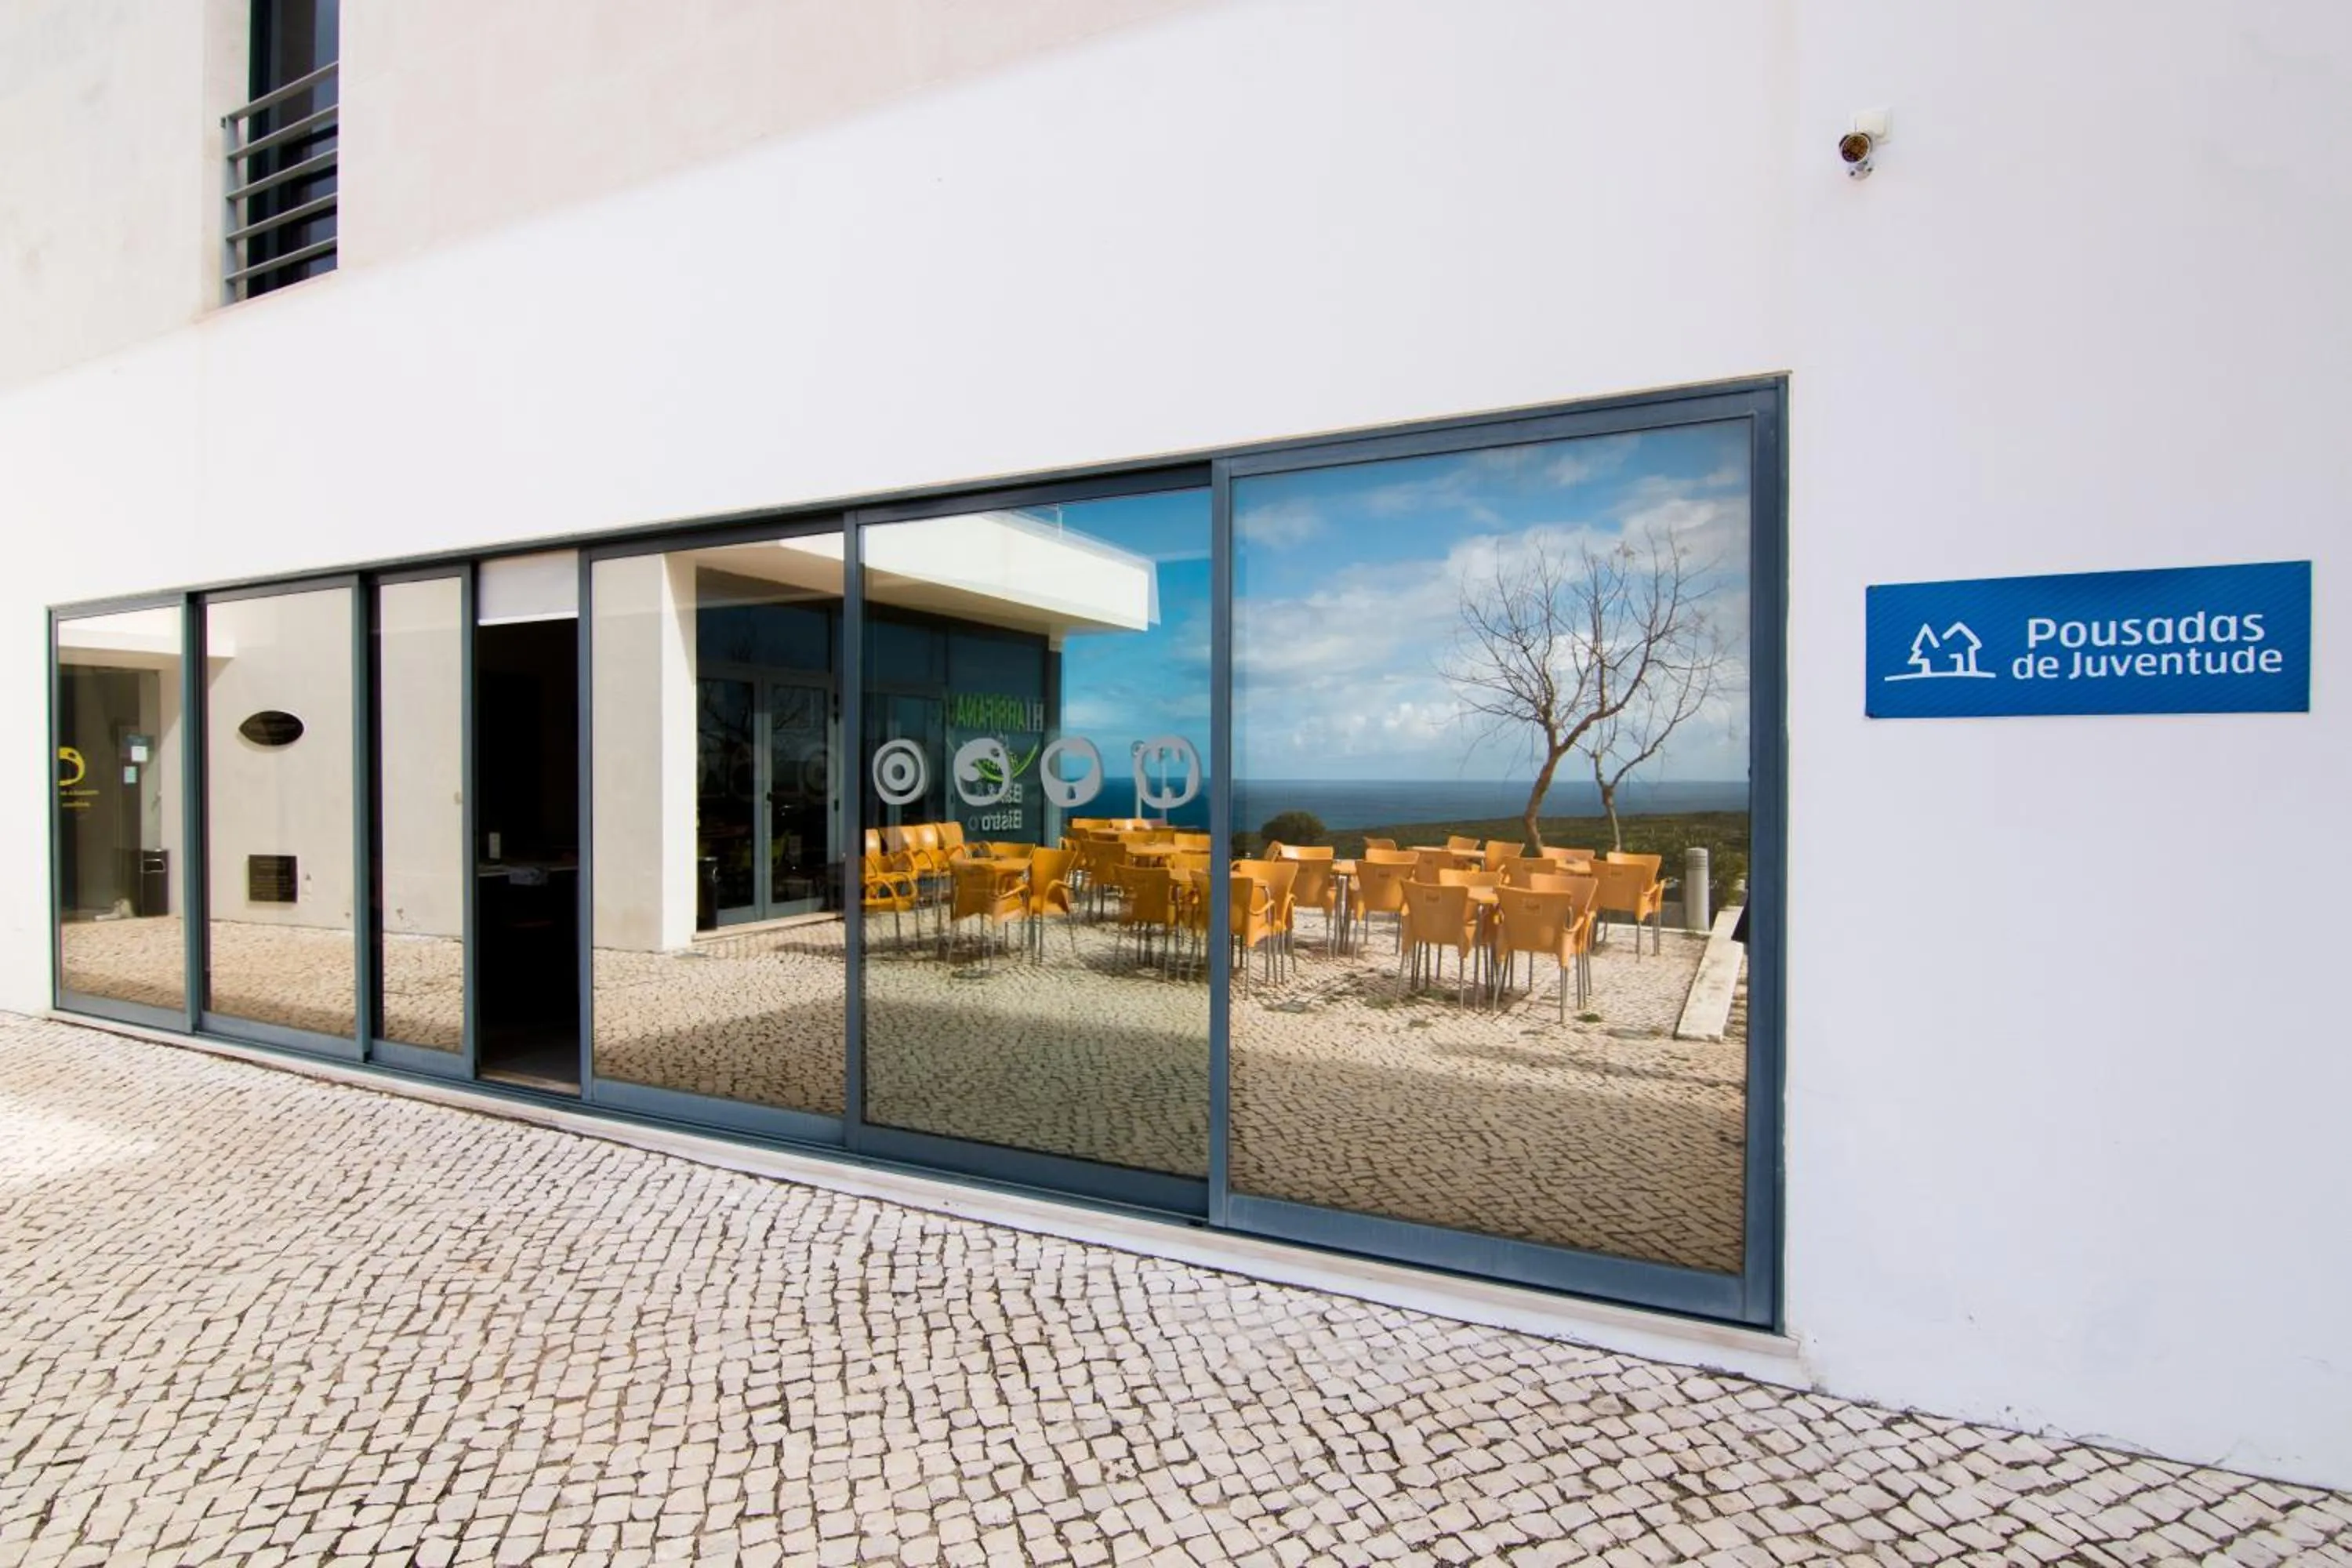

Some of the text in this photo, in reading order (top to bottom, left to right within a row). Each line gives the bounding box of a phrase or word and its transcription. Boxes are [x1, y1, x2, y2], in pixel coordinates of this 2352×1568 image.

[2027, 610, 2266, 649] Pousadas
[2012, 645, 2283, 681] de Juventude
